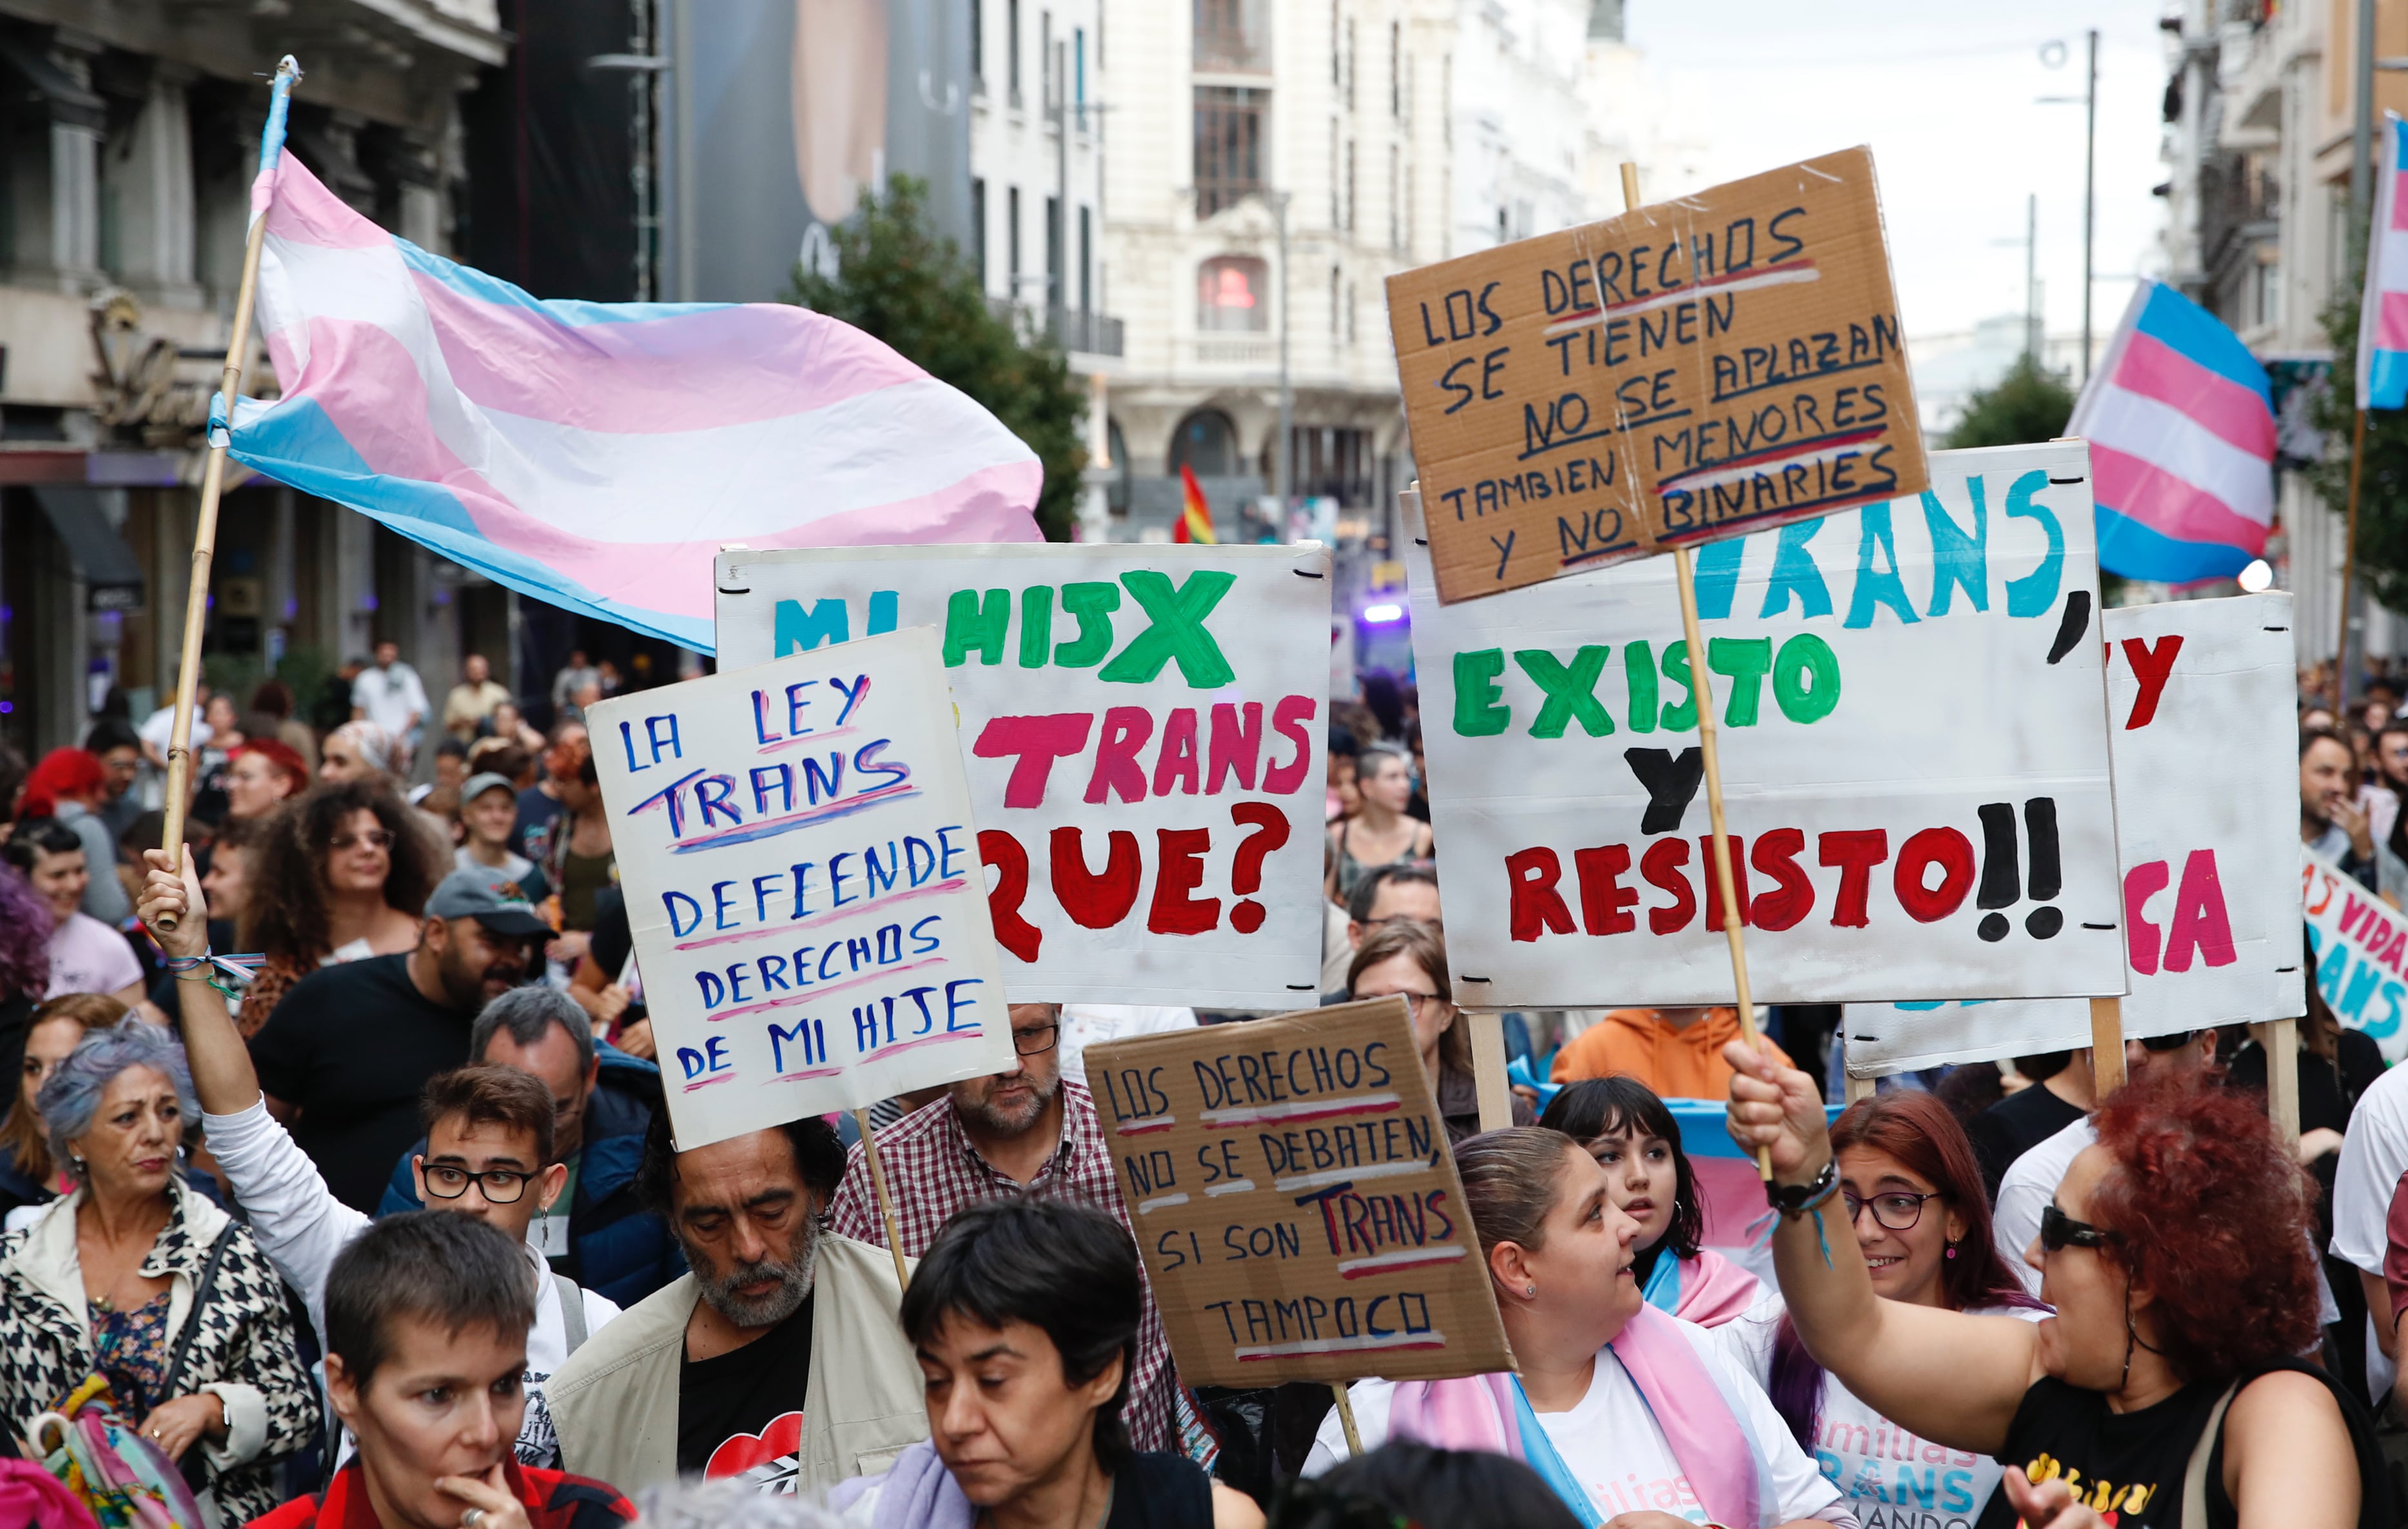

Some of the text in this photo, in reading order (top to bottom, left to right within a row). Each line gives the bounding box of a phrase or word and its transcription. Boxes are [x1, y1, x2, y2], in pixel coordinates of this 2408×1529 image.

[1421, 207, 1806, 347] LOS DERECHOS
[1440, 291, 1736, 415] SE TIENEN
[1523, 315, 1899, 455] NO SE APLAZAN
[1442, 385, 1886, 522] TAMBIEN MENORES
[1490, 444, 1897, 580] Y NO BINARIES
[774, 569, 1237, 689] MI HIJX
[620, 713, 683, 773] LA
[752, 674, 872, 745] LEY
[1453, 633, 1841, 740] EXISTO
[627, 739, 911, 840] TRANS
[974, 695, 1316, 809] TRANS
[1623, 747, 1705, 835] Y
[661, 825, 966, 938] DEFIENDE
[977, 802, 1291, 963] QUE?
[1506, 796, 2064, 943] RESISTO!!
[695, 915, 942, 1010] DERECHOS
[2338, 891, 2408, 983] VIDA
[676, 979, 984, 1080] DE MI HIJE
[1104, 1041, 1391, 1122] LOS DERECHOS
[1124, 1116, 1440, 1197] NO SE DEBATEN,
[1157, 1181, 1456, 1272] SI SON TRANS
[1204, 1292, 1432, 1345] TAMPOCO
